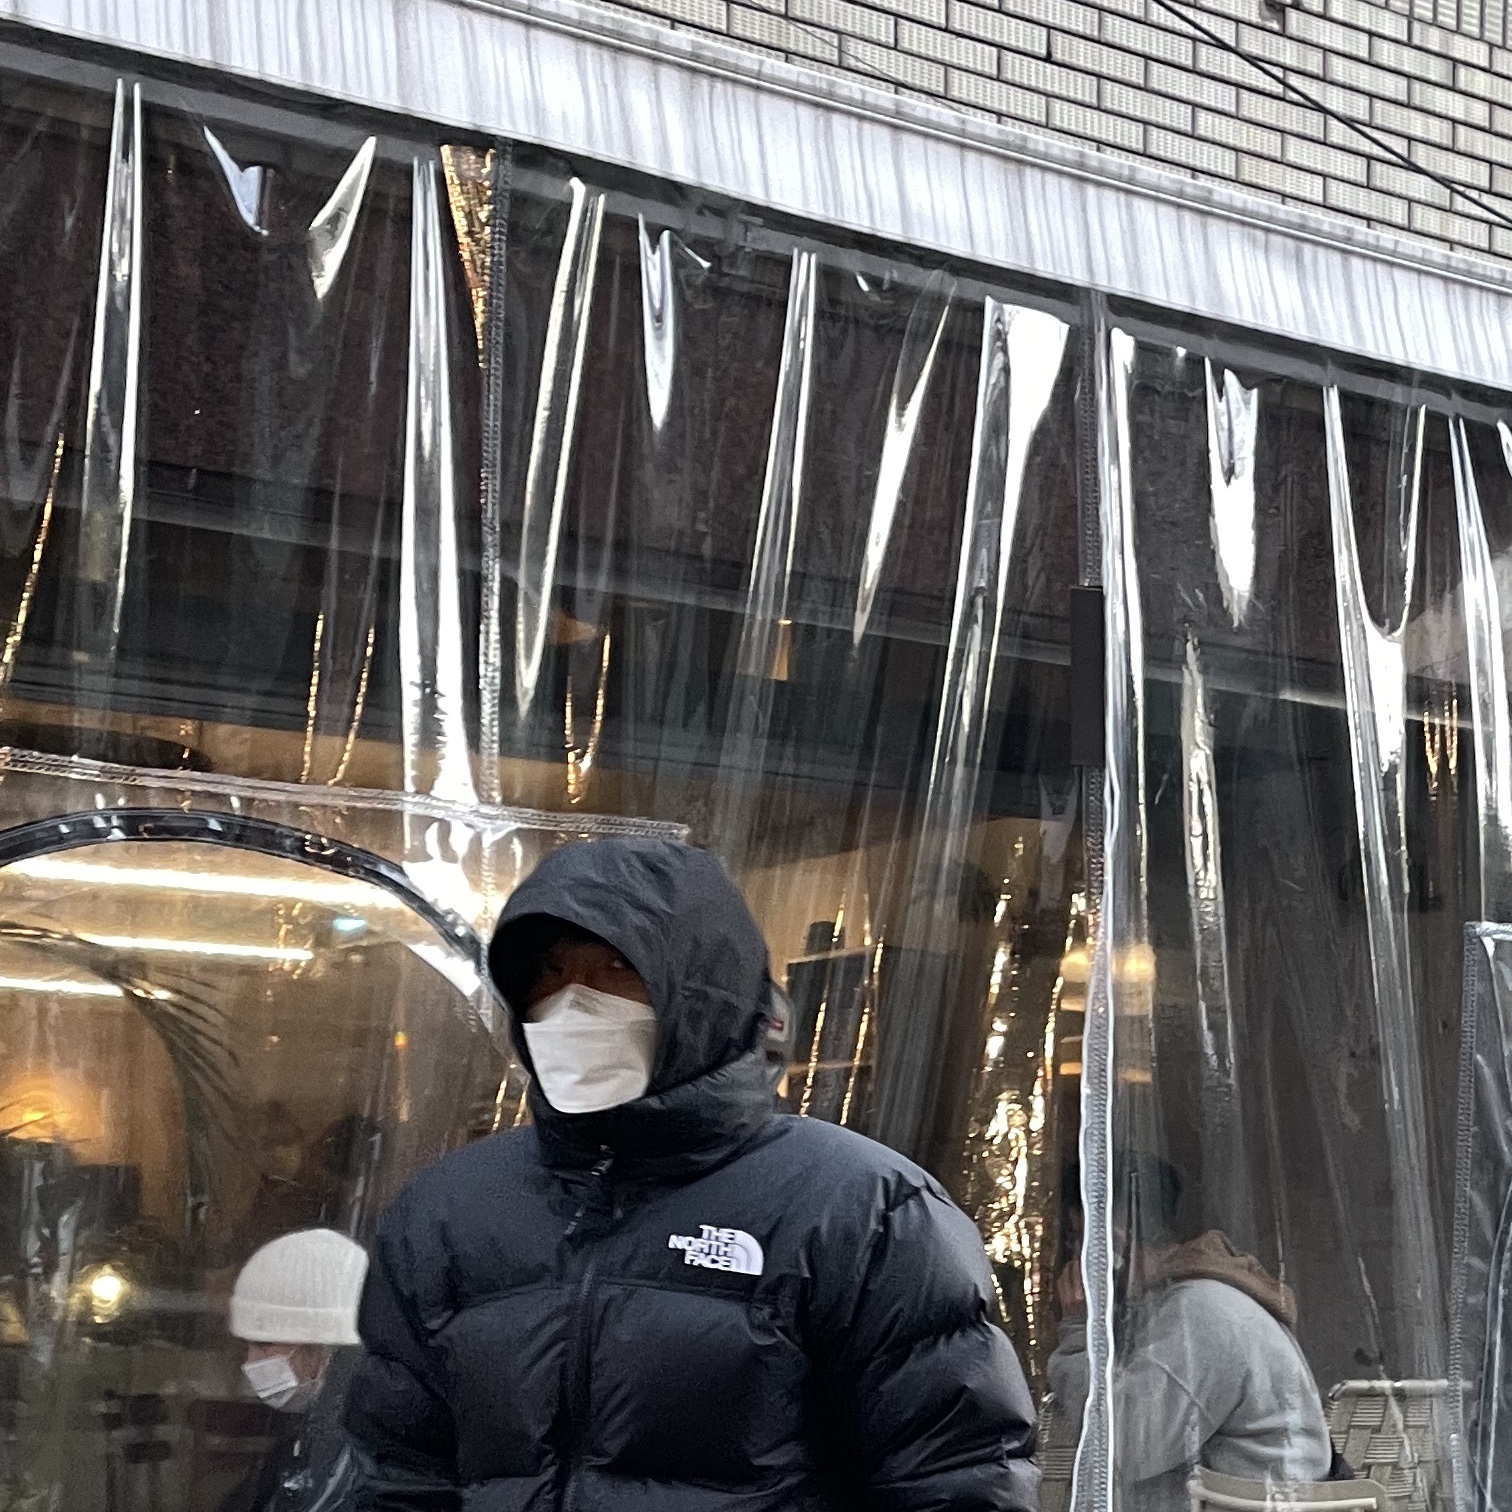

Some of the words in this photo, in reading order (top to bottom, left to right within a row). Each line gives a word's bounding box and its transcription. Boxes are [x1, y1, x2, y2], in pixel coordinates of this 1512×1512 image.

[699, 1224, 735, 1242] THE
[668, 1234, 733, 1257] NORTH
[684, 1249, 731, 1271] FACE
